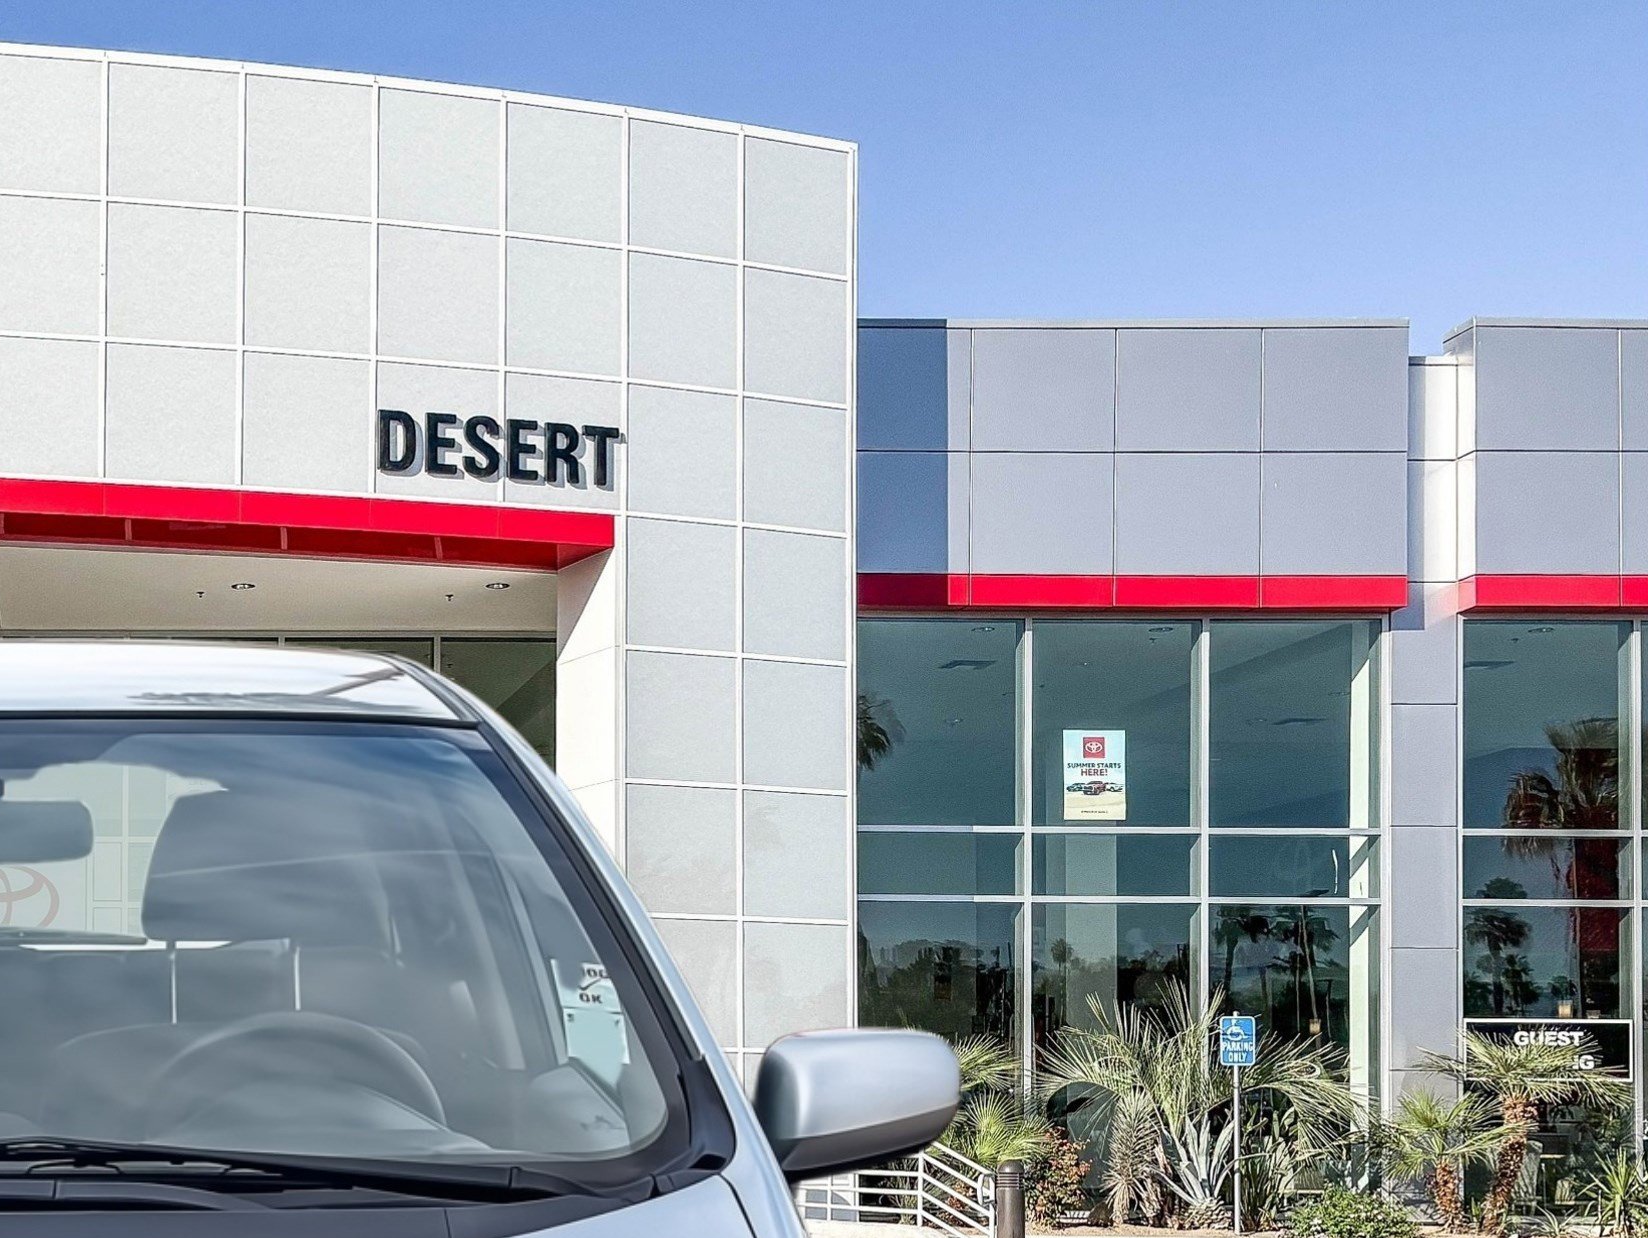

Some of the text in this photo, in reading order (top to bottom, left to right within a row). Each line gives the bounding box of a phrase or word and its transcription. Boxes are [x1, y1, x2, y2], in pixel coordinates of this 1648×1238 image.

[377, 409, 620, 486] DESERT
[1513, 1031, 1584, 1047] GUEST
[1222, 1041, 1253, 1052] PARKING
[1228, 1051, 1247, 1062] ONLY
